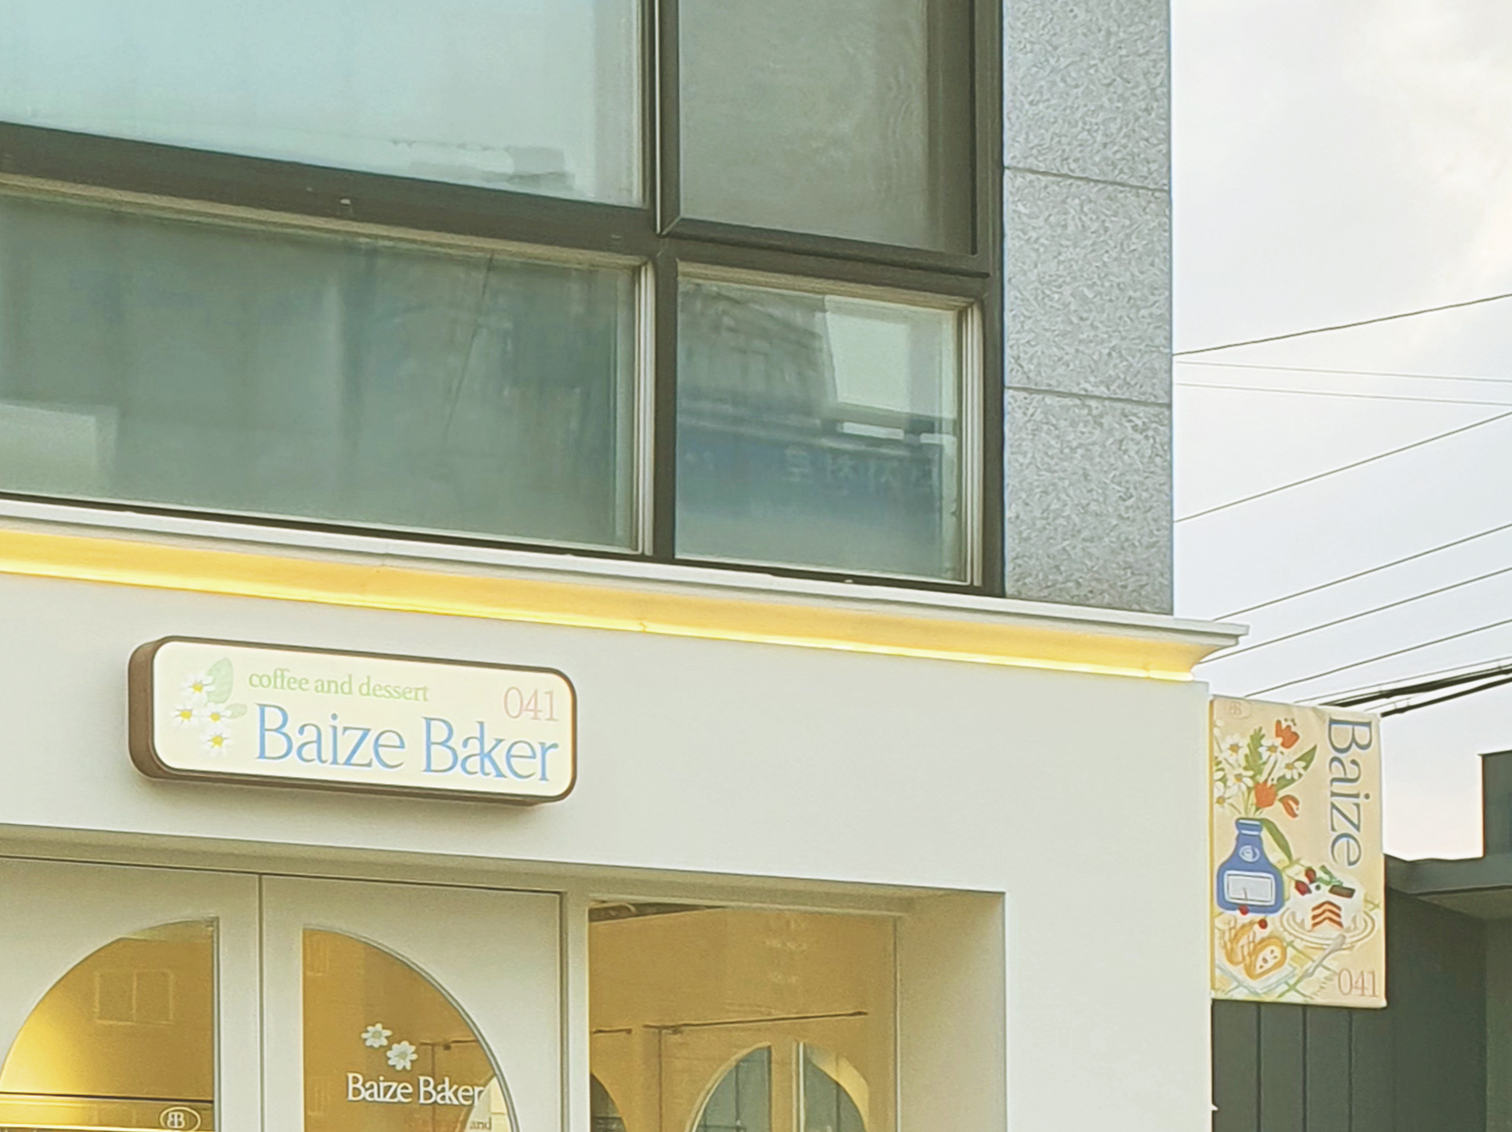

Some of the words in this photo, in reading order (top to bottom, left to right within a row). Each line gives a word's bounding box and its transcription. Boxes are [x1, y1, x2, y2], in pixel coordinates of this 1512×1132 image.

[248, 668, 310, 691] coffee
[314, 674, 353, 695] and
[358, 675, 430, 702] dessert
[503, 686, 559, 722] 041
[256, 703, 406, 769] Baize
[422, 716, 560, 782] Baker
[1327, 717, 1374, 867] Baize
[1338, 968, 1379, 998] 041
[346, 1072, 413, 1103] Baize
[418, 1076, 485, 1106] Baker
